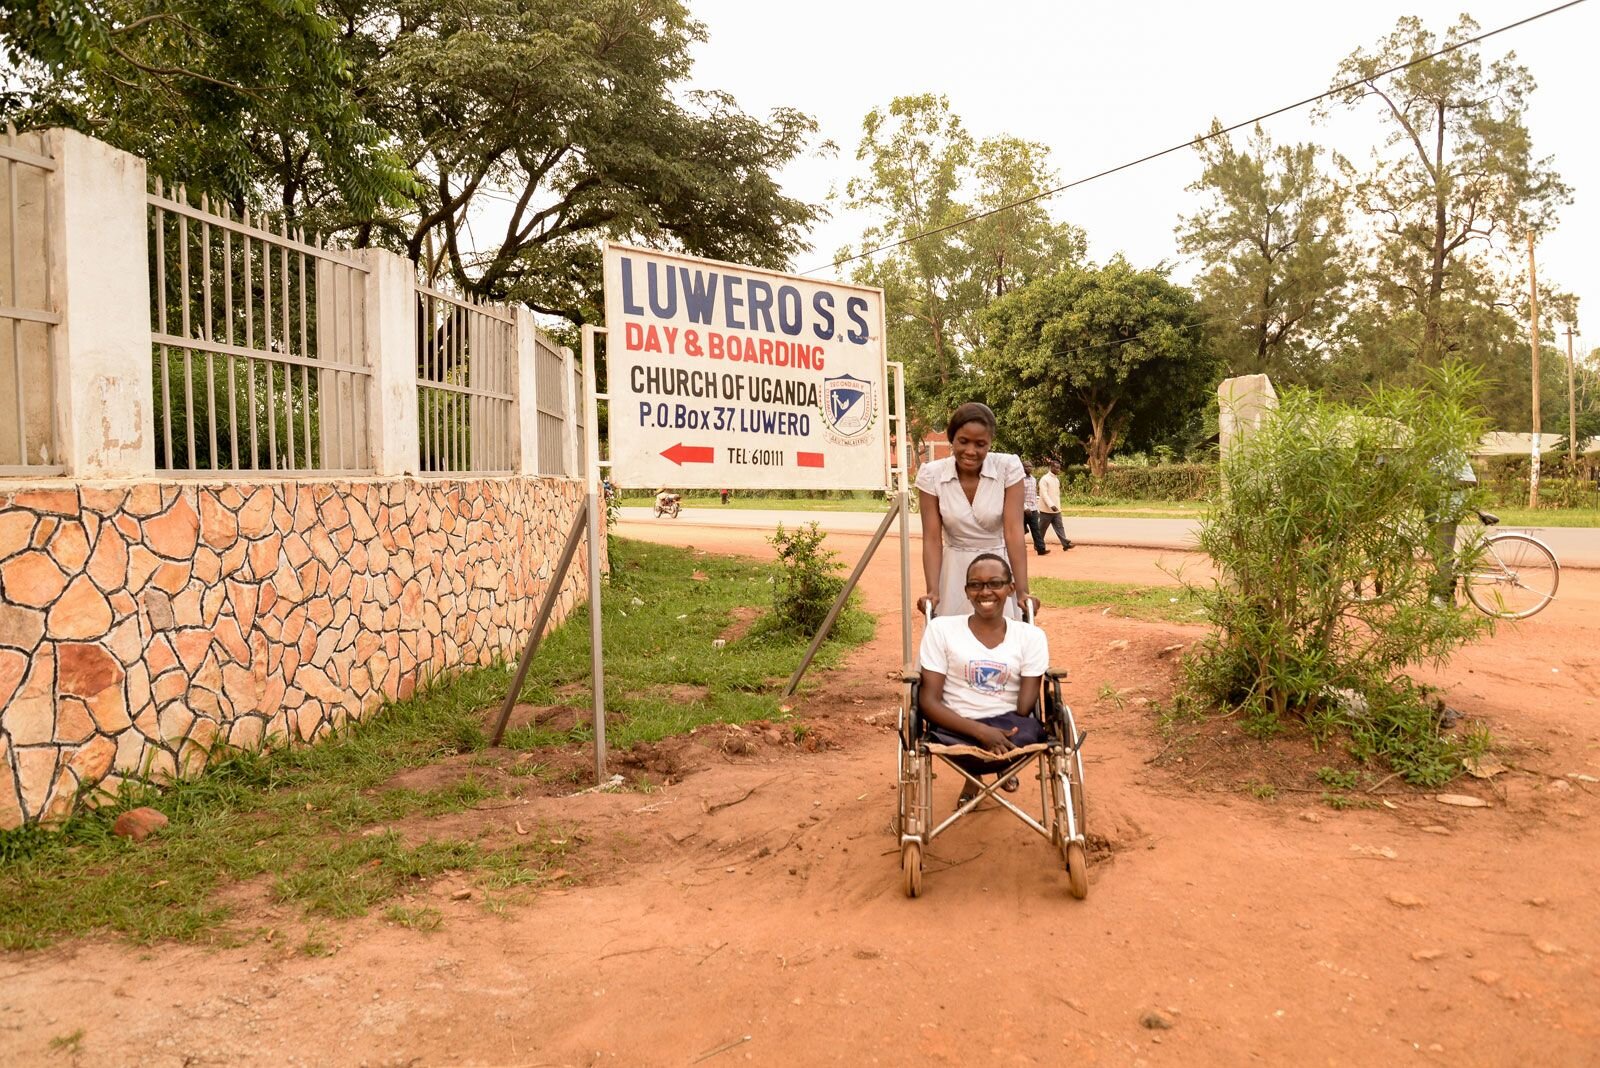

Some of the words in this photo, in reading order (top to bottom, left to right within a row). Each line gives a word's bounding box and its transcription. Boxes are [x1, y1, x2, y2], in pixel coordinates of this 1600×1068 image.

[620, 257, 802, 336] LUWERO
[625, 322, 679, 354] DAY
[684, 329, 705, 357] &
[708, 331, 825, 371] BOARDING
[630, 365, 717, 399] CHURCH
[722, 373, 745, 400] OF
[748, 376, 819, 407] UGANDA
[740, 408, 810, 437] LUWERO
